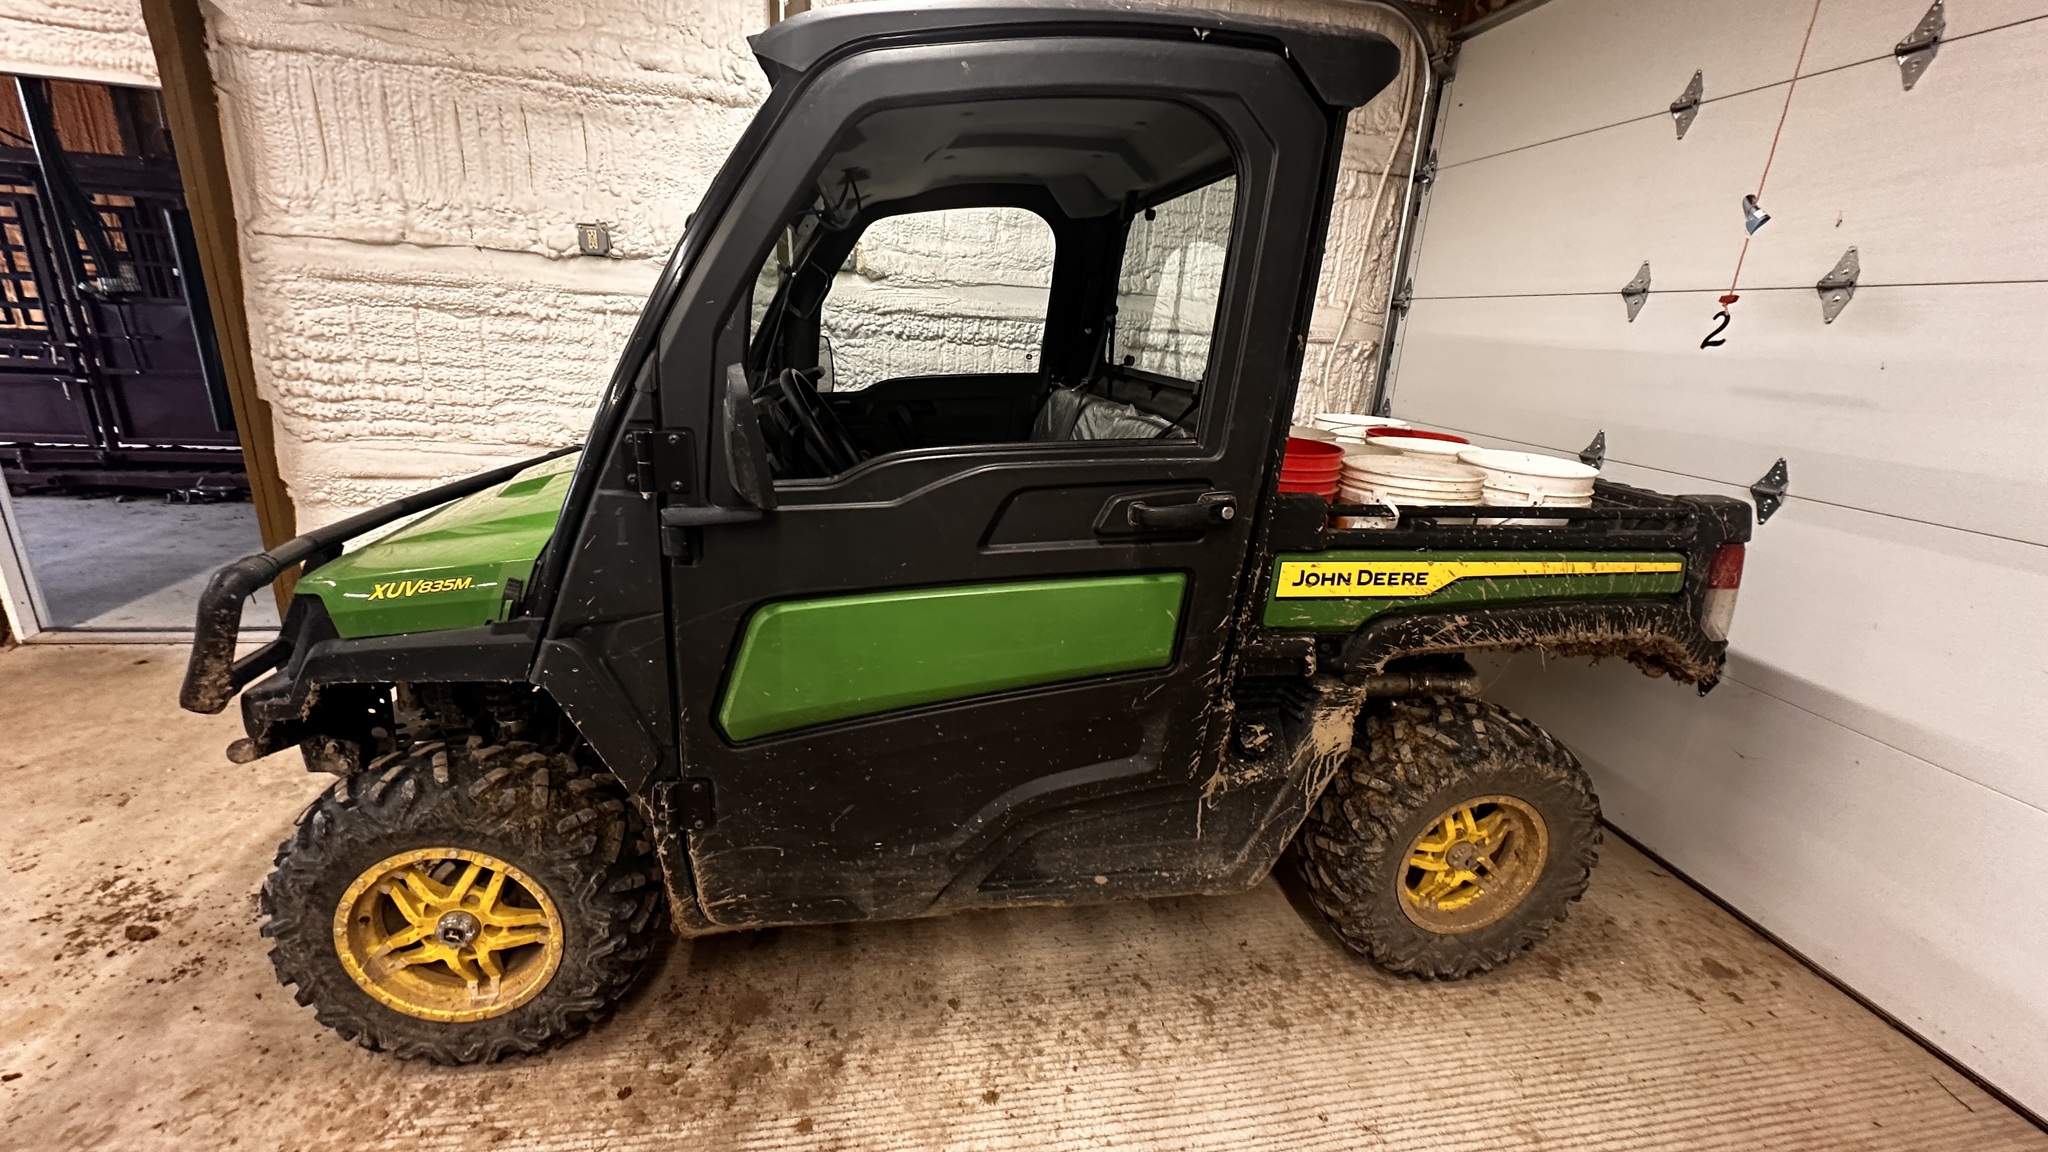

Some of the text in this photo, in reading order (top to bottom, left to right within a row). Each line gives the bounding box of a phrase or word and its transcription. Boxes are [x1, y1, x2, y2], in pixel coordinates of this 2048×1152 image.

[1700, 310, 1731, 350] 2
[368, 577, 473, 601] XUV835M
[1292, 569, 1429, 587] JOHN DEERE
